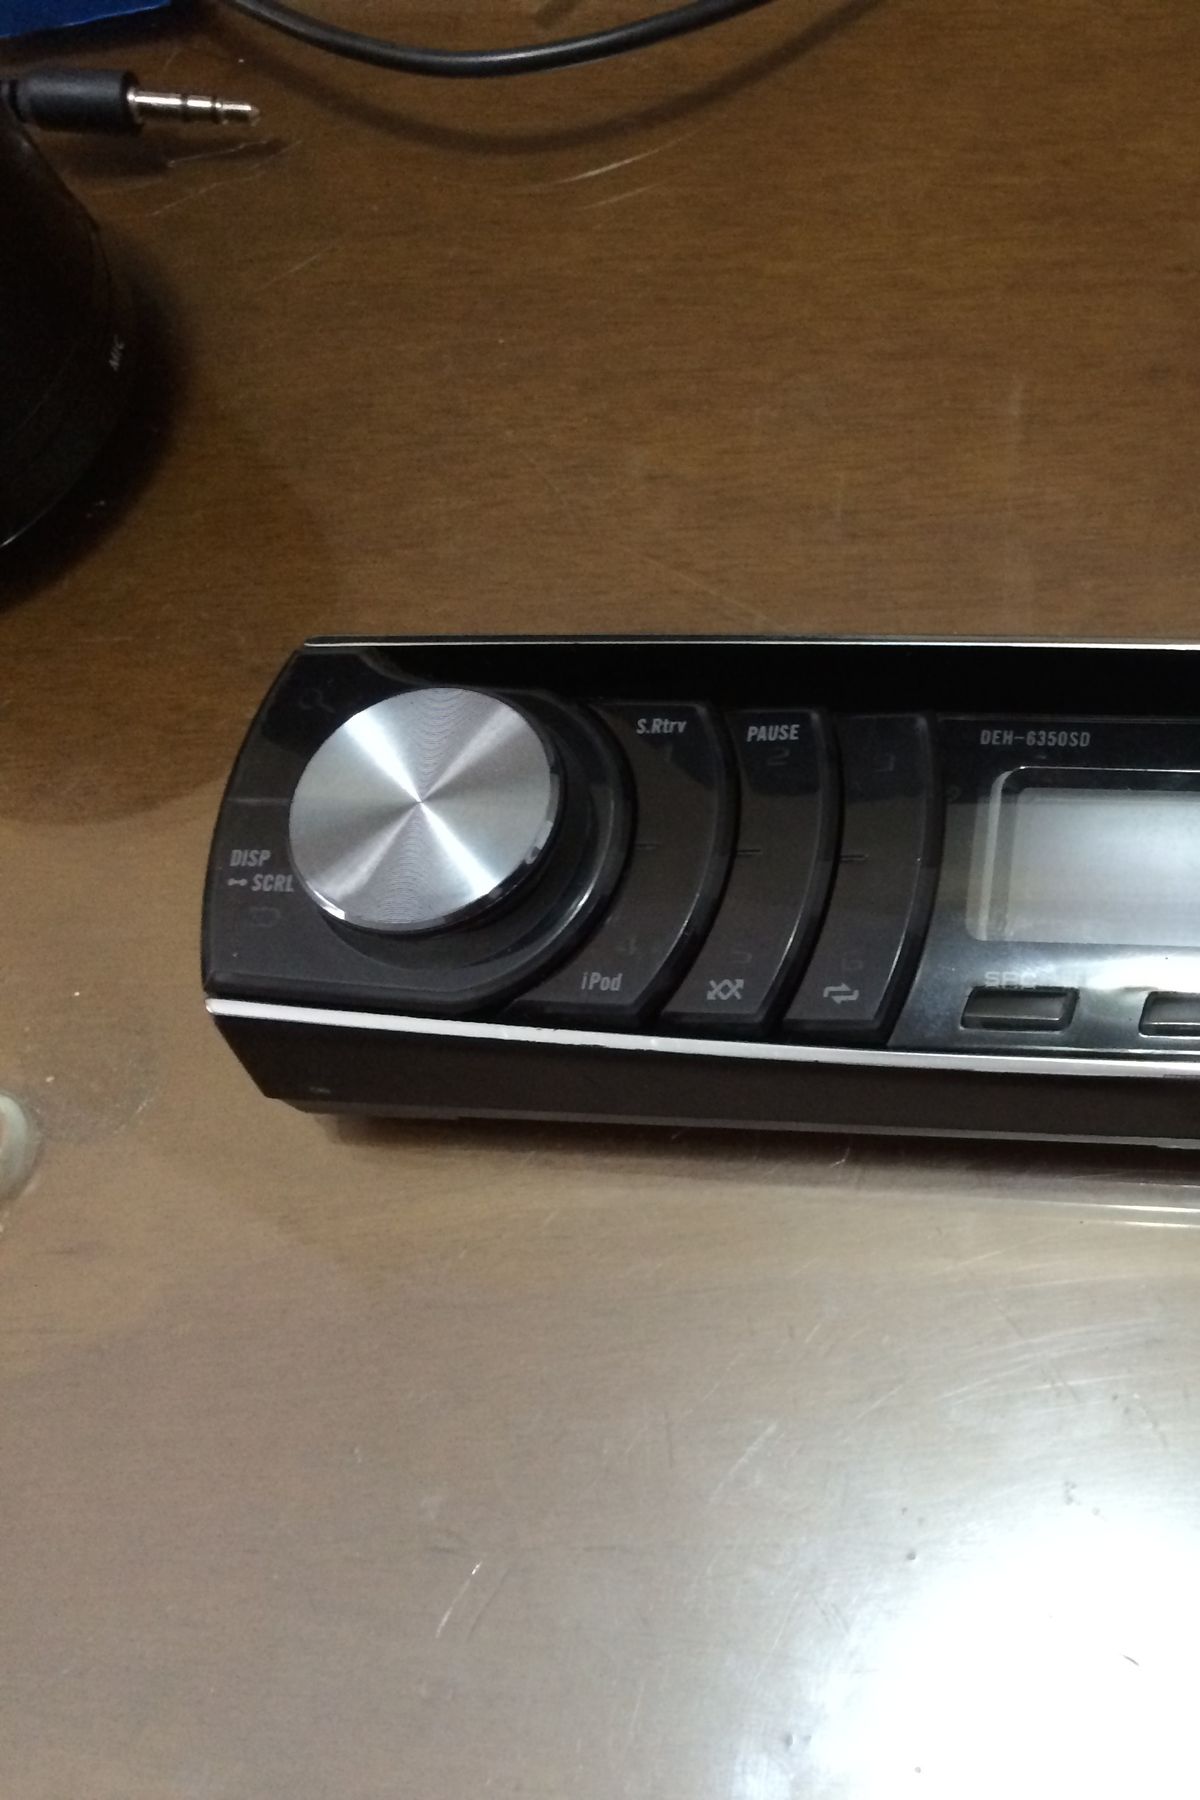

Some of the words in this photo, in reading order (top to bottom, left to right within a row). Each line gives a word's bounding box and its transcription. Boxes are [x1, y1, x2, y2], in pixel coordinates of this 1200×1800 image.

[636, 718, 687, 735] S.Rtrv
[746, 724, 800, 742] PAUSE
[980, 729, 1091, 748] DEH-6350SD
[229, 849, 272, 867] DISP
[251, 873, 295, 892] SCRL
[581, 971, 623, 992] iPod
